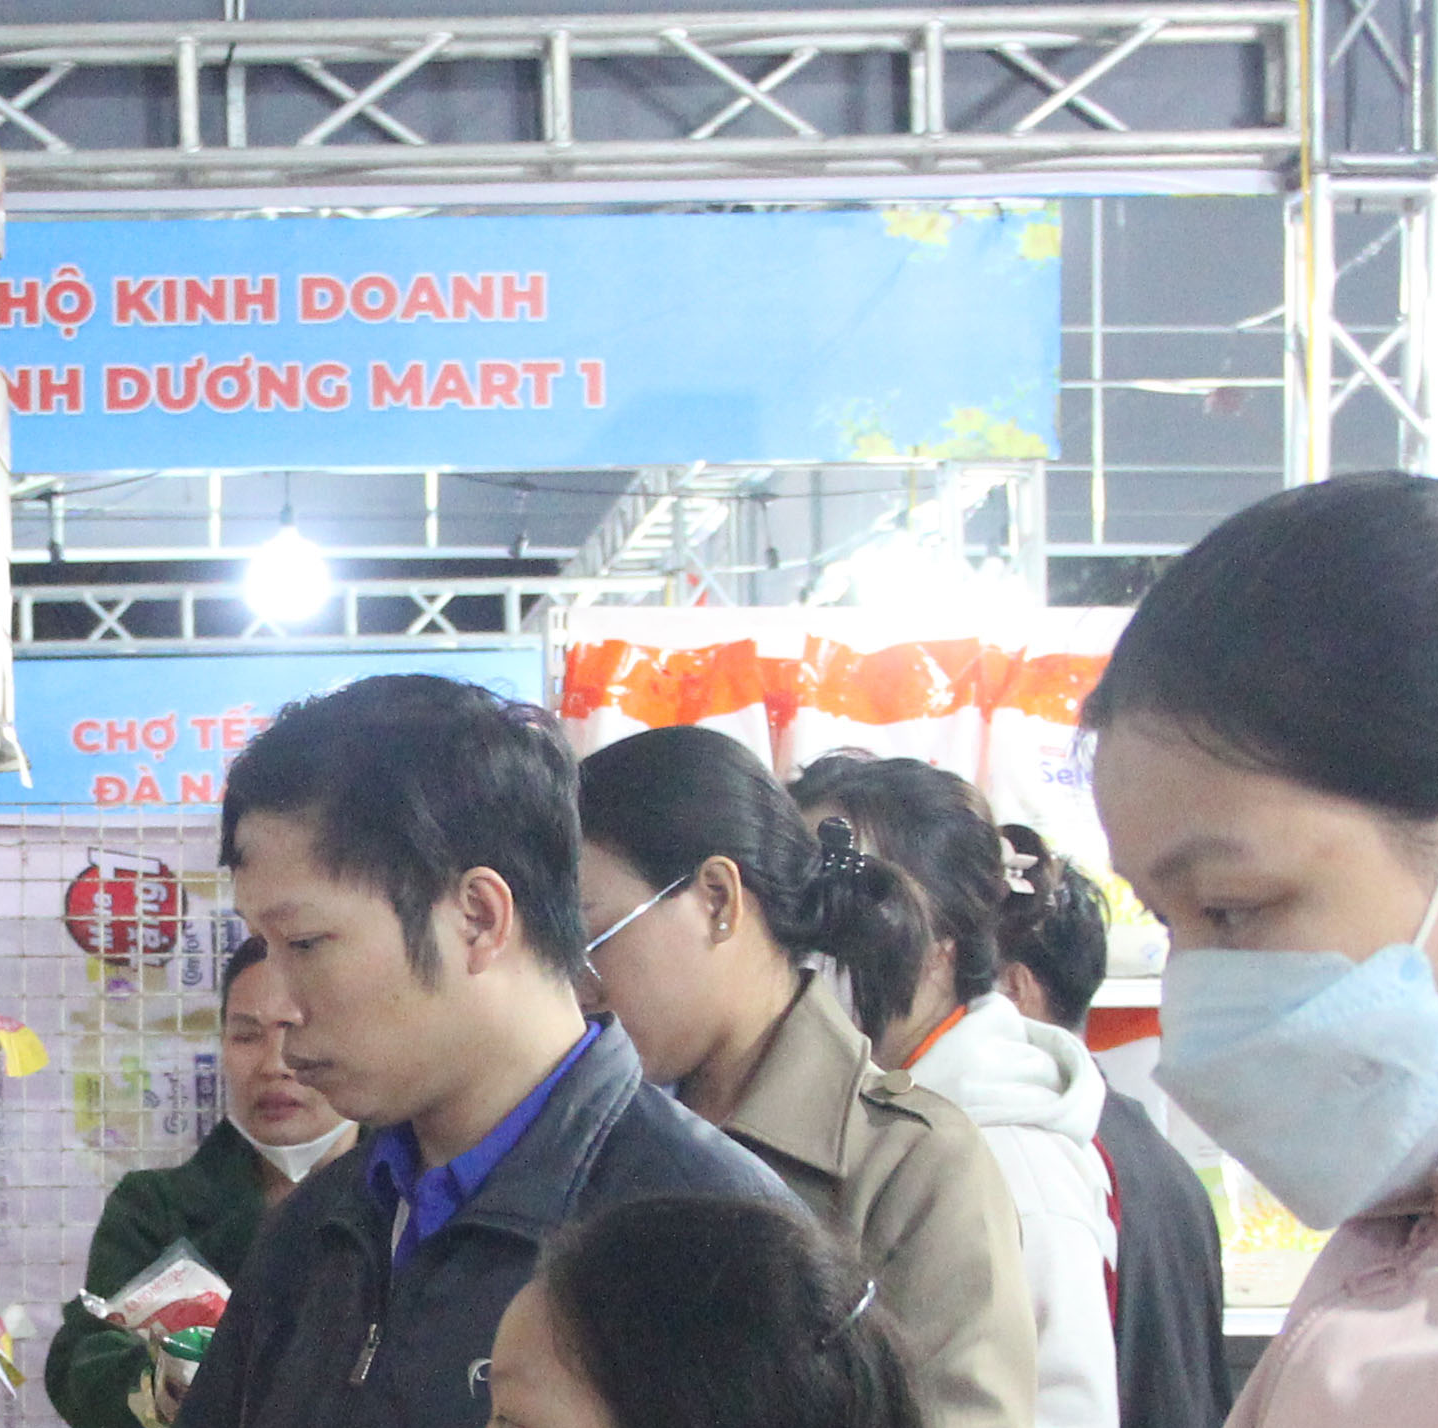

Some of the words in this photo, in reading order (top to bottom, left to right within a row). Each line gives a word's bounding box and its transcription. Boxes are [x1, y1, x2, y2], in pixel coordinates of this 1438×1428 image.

[115, 277, 276, 324] KINH
[299, 273, 547, 322] DOANH
[1, 366, 82, 412] NH
[105, 356, 349, 412] DƯƠNG
[371, 361, 563, 409] MART
[579, 361, 606, 406] 1
[72, 712, 177, 761] CHỢ
[93, 765, 164, 807] ĐÀ
